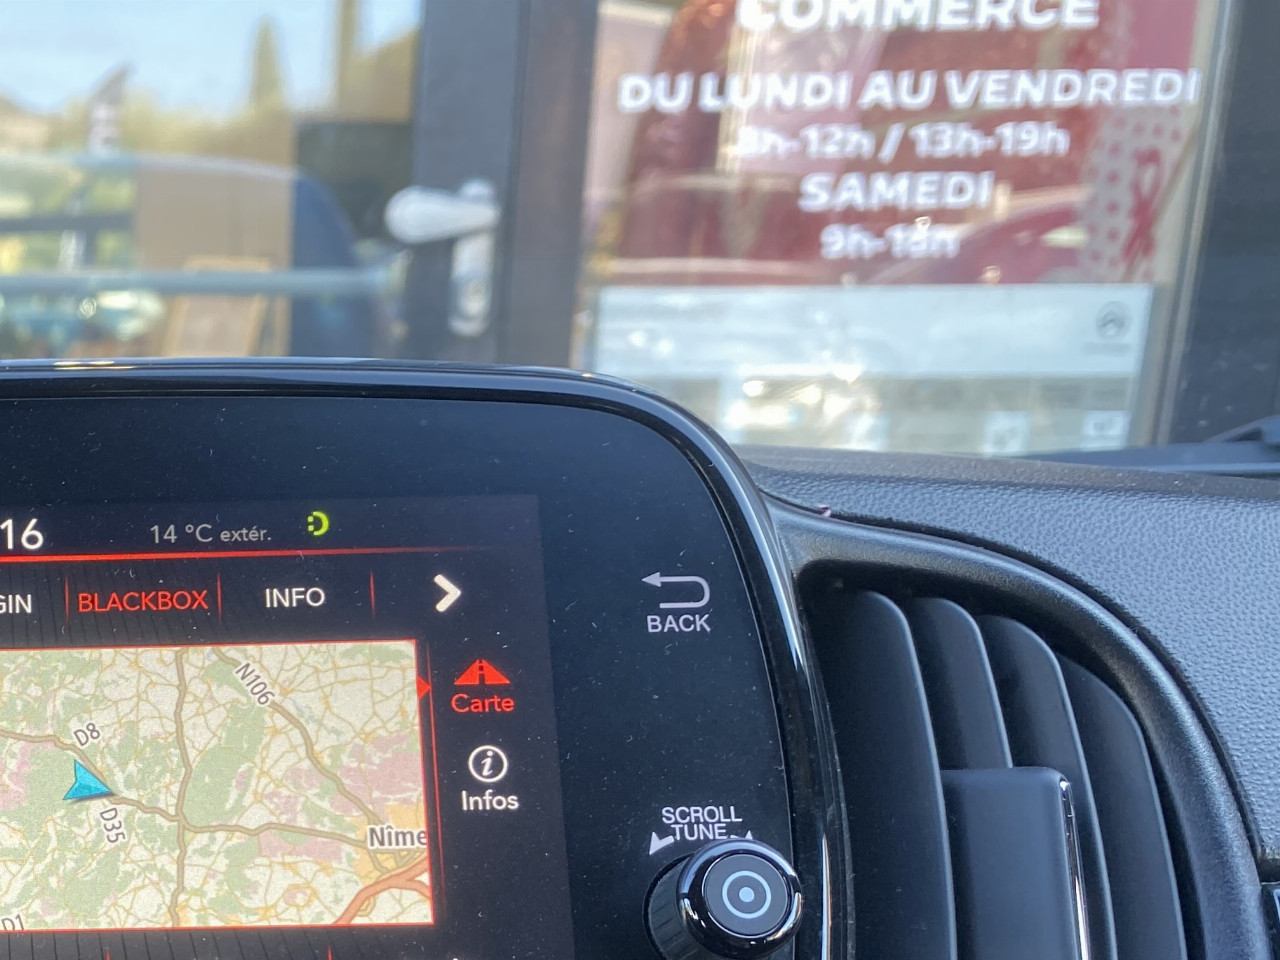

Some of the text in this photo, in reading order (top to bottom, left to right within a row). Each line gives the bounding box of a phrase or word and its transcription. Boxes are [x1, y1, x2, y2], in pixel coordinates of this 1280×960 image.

[736, 0, 1099, 30] COMMERCE
[618, 68, 1201, 113] DU LUNDI AU VENDREDI
[908, 121, 1071, 158] 13h-19h
[798, 170, 996, 212] SAMEDI
[150, 525, 178, 544] 14
[220, 525, 272, 543] extér.
[77, 590, 210, 613] BLACKBOX
[265, 587, 326, 608] INFO
[646, 614, 712, 633] BACK
[234, 661, 274, 707] N106
[450, 692, 515, 715] Carte
[73, 723, 101, 749] D8
[461, 791, 519, 812] Infos
[99, 808, 126, 845] D35
[662, 806, 743, 825] SCROLL
[369, 825, 428, 847] Nîme
[671, 823, 727, 841] TUNE
